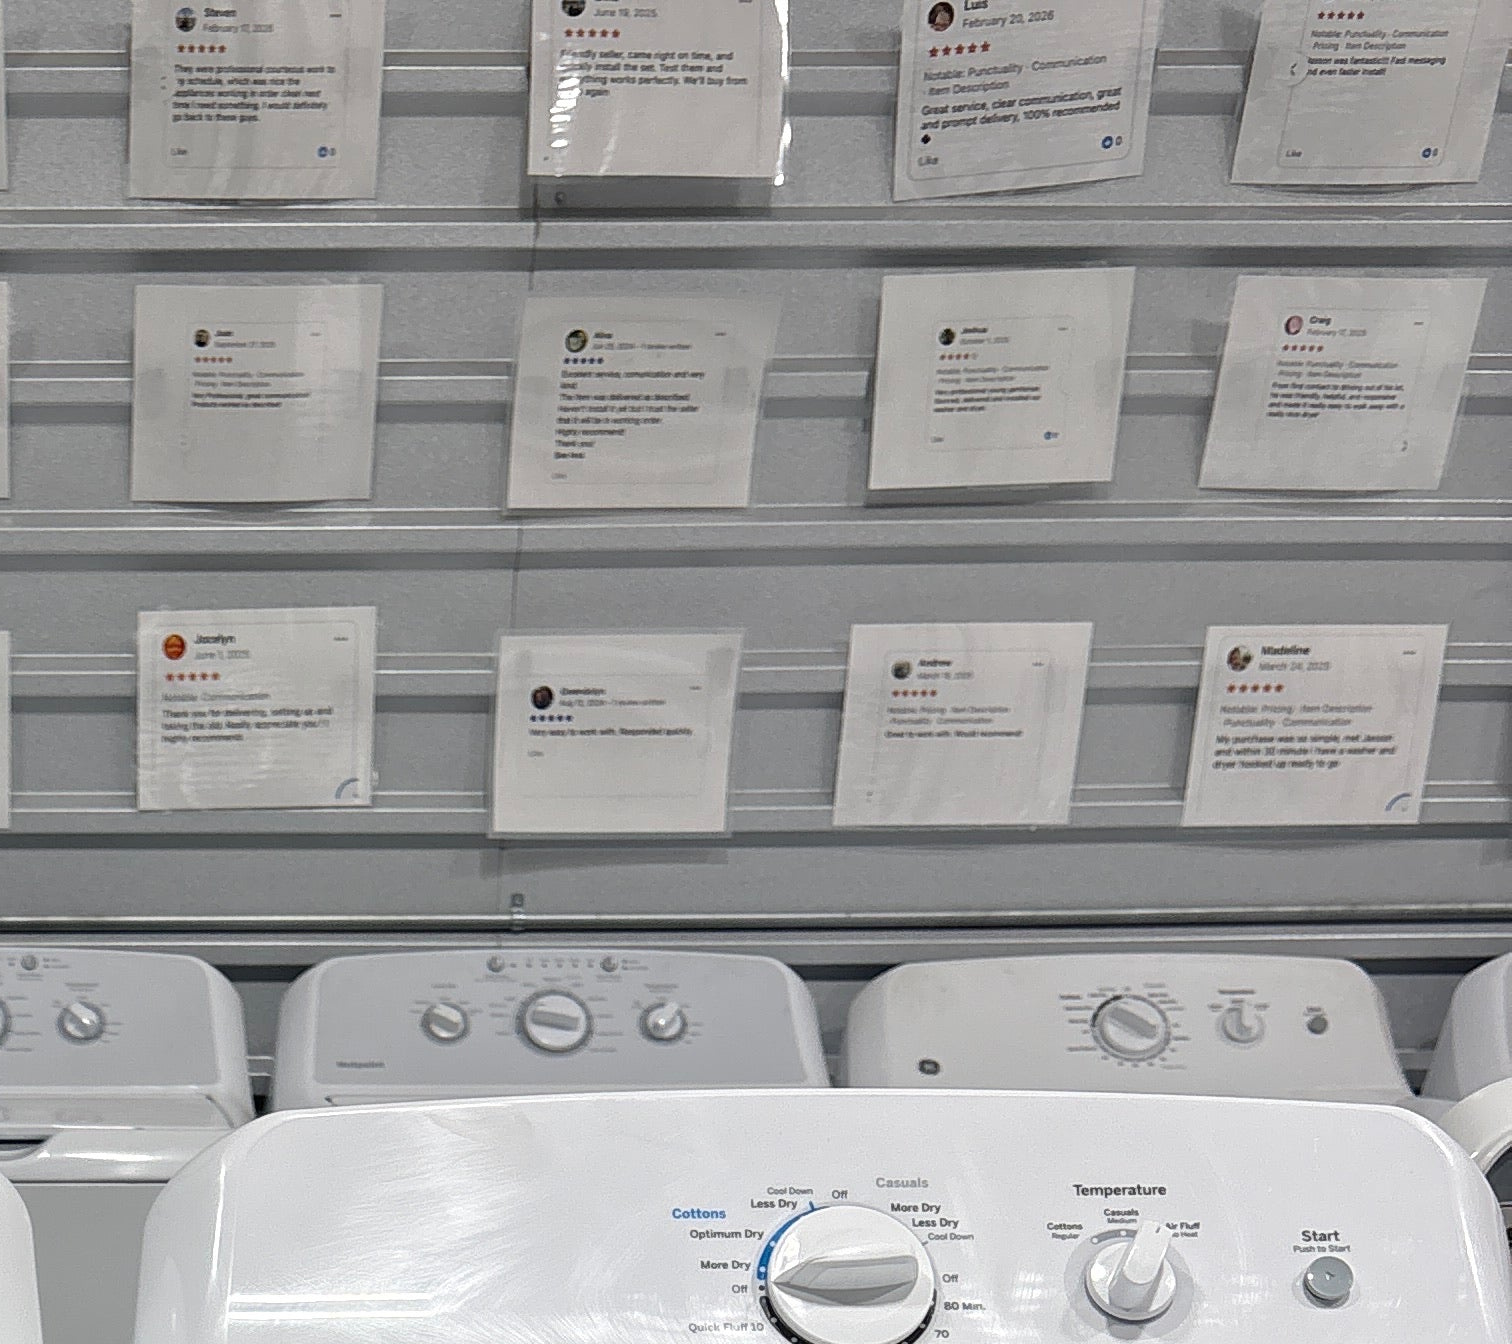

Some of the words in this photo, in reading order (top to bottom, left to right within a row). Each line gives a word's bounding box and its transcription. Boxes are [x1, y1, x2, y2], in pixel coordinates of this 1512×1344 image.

[962, 16, 1007, 28] February
[716, 52, 734, 60] and
[706, 63, 724, 72] and
[968, 62, 1023, 77] Punctuality
[1031, 55, 1107, 72] Communication
[929, 86, 950, 96] Item
[952, 81, 1009, 95] Description
[921, 105, 949, 116] Great
[992, 99, 1016, 110] clear
[1096, 87, 1122, 101] great
[920, 120, 939, 130] and
[941, 115, 977, 130] prompt
[1052, 100, 1120, 117] recommended
[875, 1177, 929, 1188] Casuals
[767, 1187, 787, 1196] Cool
[788, 1187, 814, 1196] Down
[831, 1189, 849, 1199] Off
[1073, 1184, 1167, 1197] Temperature
[750, 1198, 776, 1209] Less
[778, 1199, 798, 1211] Dry
[890, 1203, 919, 1213] More
[921, 1203, 941, 1214] Dry
[672, 1208, 727, 1220] Cottons
[1104, 1208, 1139, 1217] Casuals
[911, 1217, 936, 1228] Less
[939, 1218, 959, 1229] Dry
[1046, 1222, 1083, 1231] Cottons
[1180, 1221, 1201, 1230] Fluff
[690, 1229, 742, 1241] Optimum
[745, 1229, 765, 1241] Dry
[927, 1232, 948, 1241] Cool
[949, 1232, 975, 1241] Down
[1301, 1230, 1340, 1243] Start
[1293, 1244, 1315, 1253] Push
[1316, 1244, 1326, 1253] to
[1328, 1244, 1351, 1253] Start
[700, 1260, 729, 1270] More
[731, 1260, 751, 1272] Dry
[942, 1273, 959, 1283] Off
[731, 1284, 748, 1294] Off
[944, 1302, 960, 1311] 80
[688, 1322, 720, 1333] Quick
[750, 1322, 764, 1332] 10
[934, 1329, 950, 1339] 70
